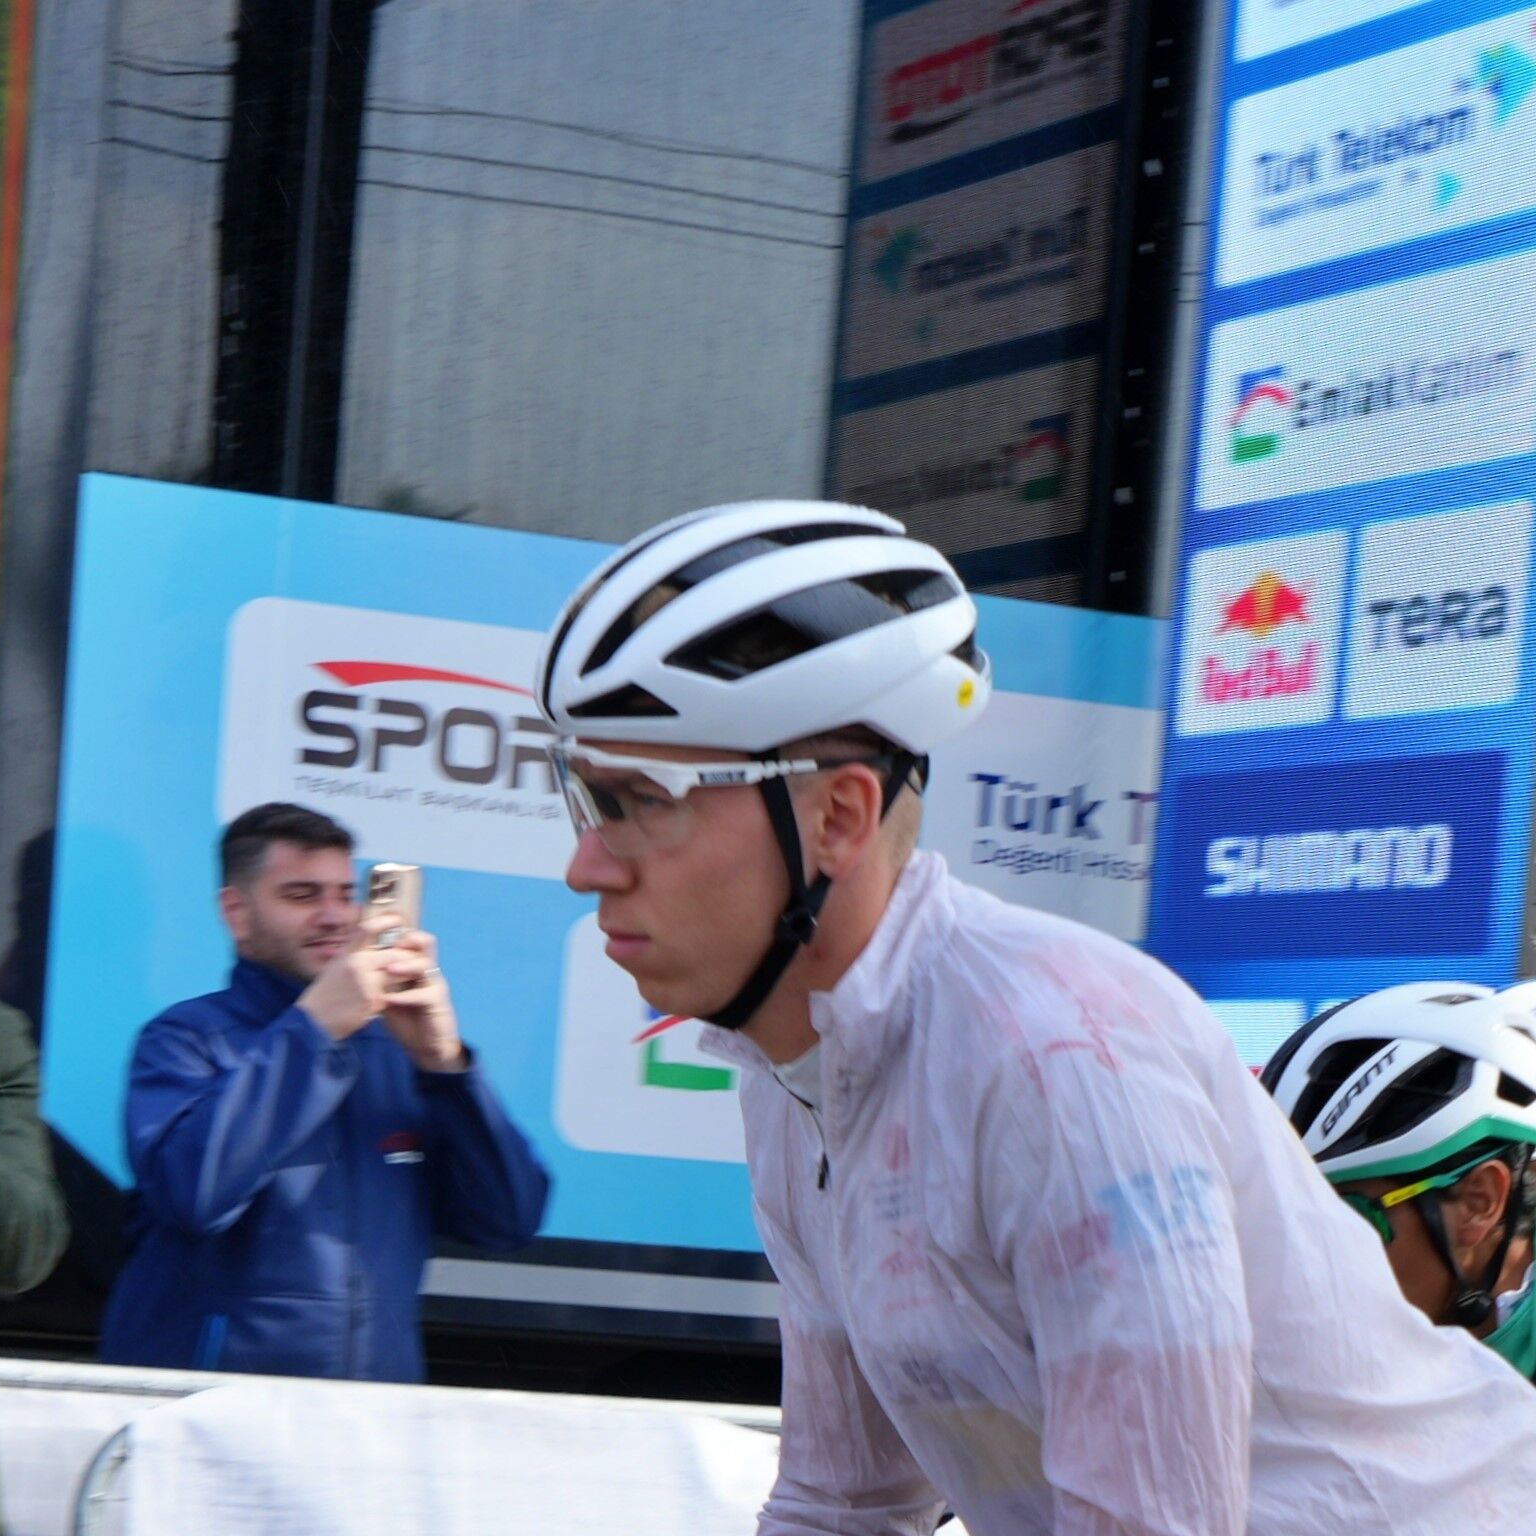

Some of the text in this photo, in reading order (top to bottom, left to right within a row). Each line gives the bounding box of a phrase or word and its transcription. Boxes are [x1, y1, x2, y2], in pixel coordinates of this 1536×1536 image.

[969, 773, 1105, 840] Türk
[1204, 823, 1453, 898] SHIMANO
[1321, 1043, 1401, 1140] GIANT
